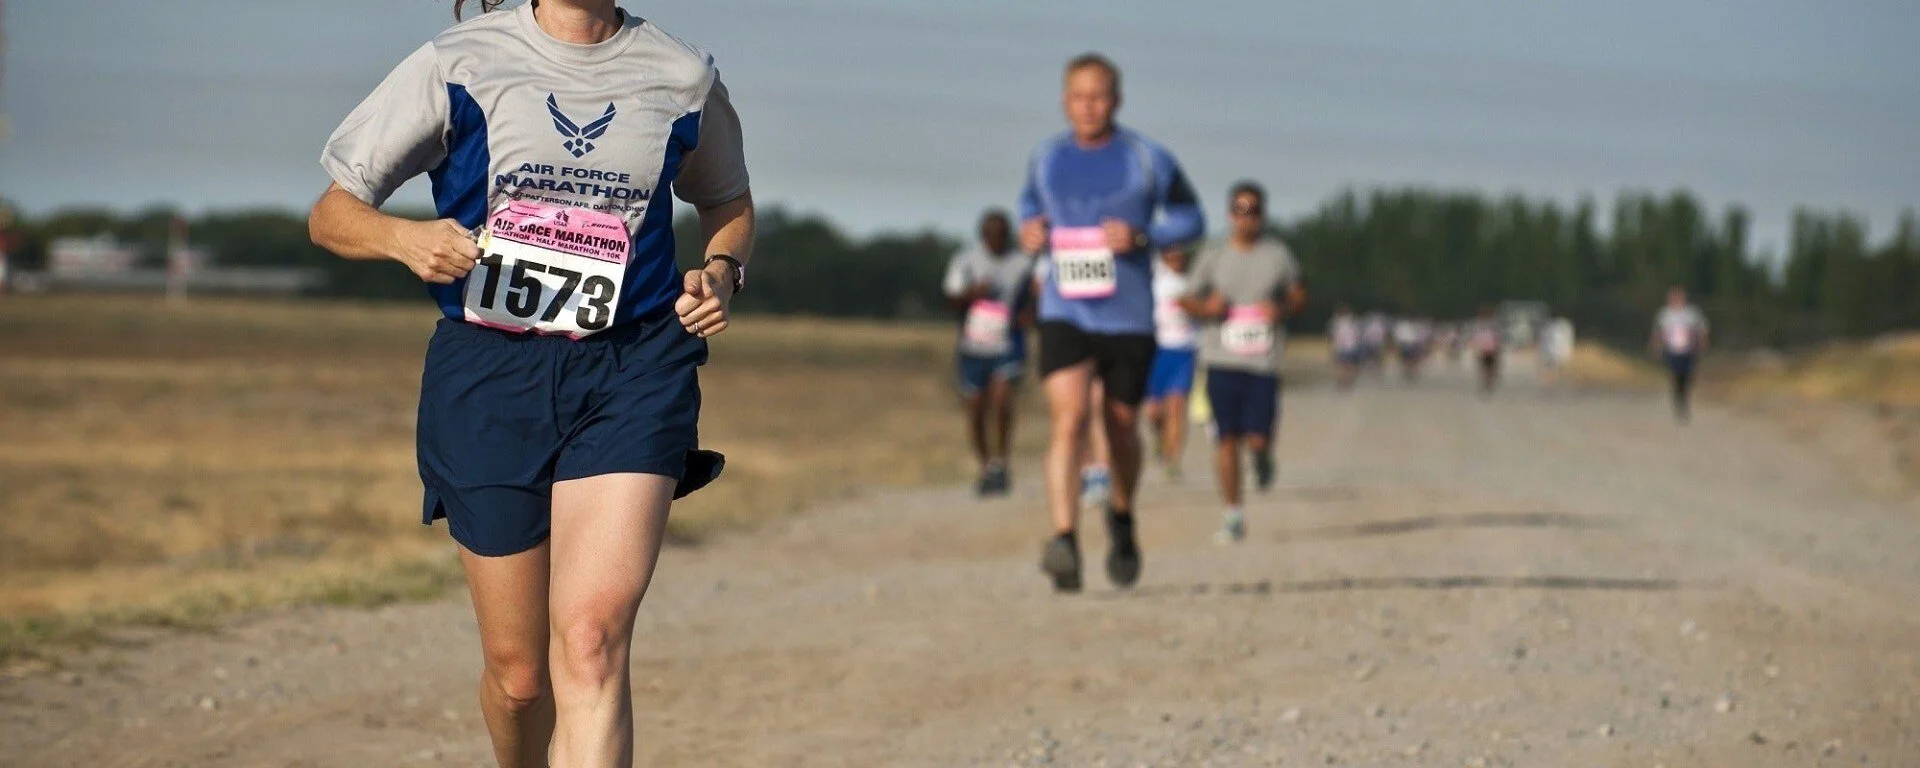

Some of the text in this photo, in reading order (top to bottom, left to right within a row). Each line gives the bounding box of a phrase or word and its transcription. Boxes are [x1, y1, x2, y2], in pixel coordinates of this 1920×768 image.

[494, 174, 651, 201] MARATHON
[518, 162, 631, 184] AIR FORCE
[497, 188, 571, 206] WT-PATTERSON
[492, 229, 531, 241] MATHON
[536, 236, 557, 246] HALF
[557, 241, 600, 256] MARATHON
[606, 251, 621, 260] 10K
[493, 217, 627, 253] AIR ORCE MARATHON
[479, 252, 616, 331] 1573
